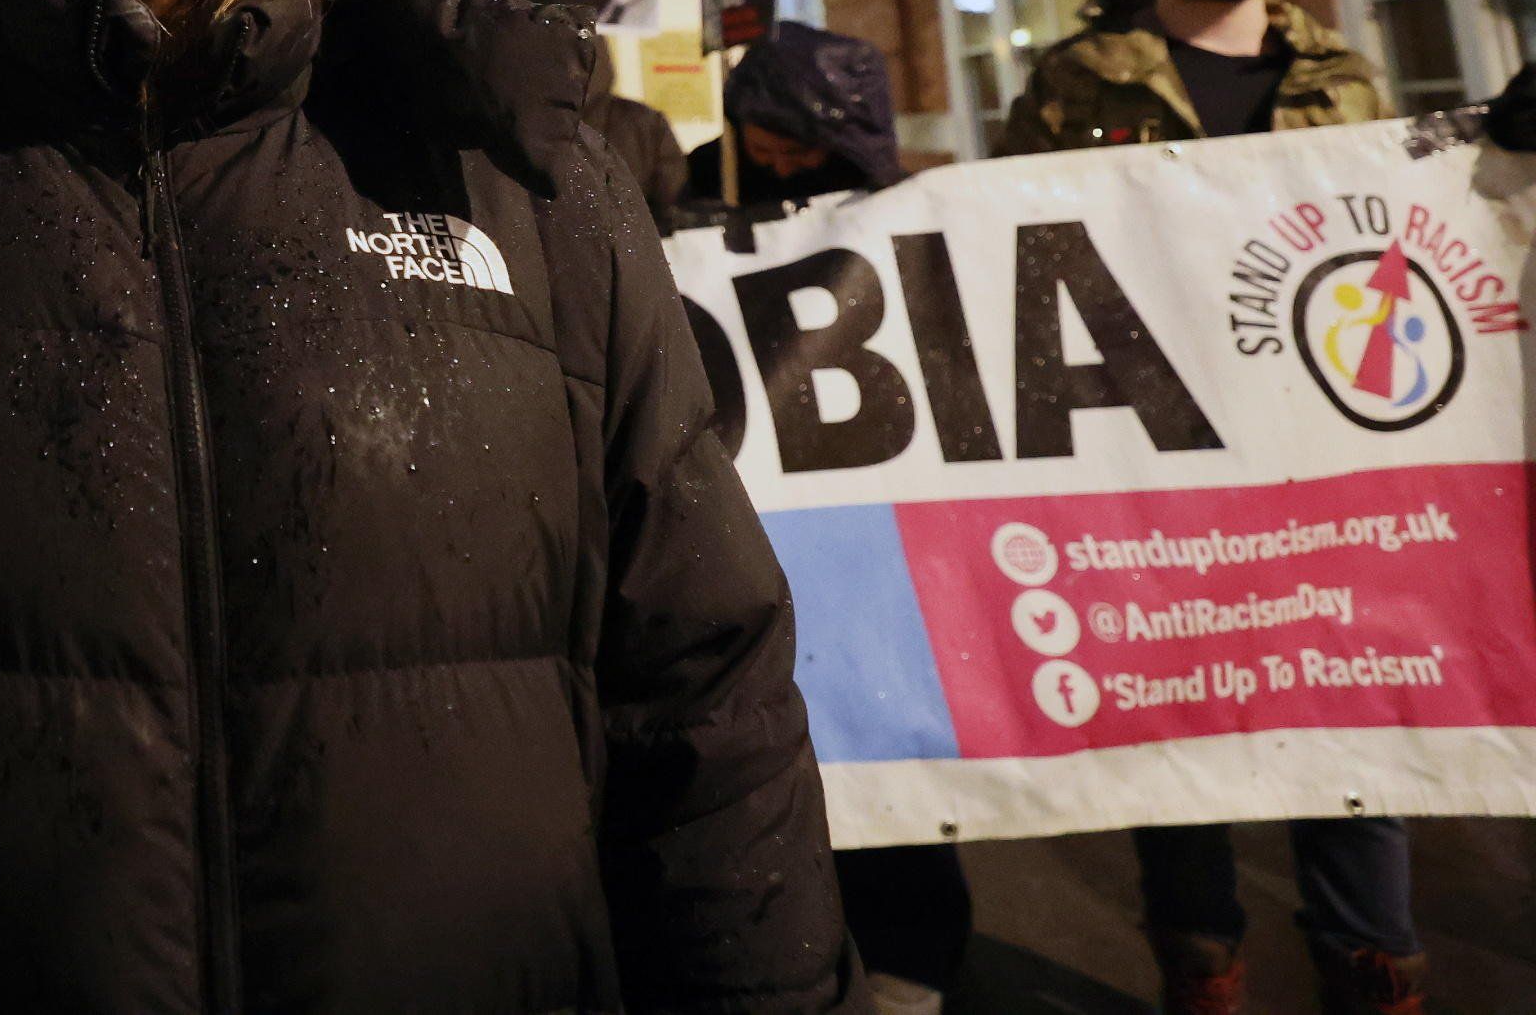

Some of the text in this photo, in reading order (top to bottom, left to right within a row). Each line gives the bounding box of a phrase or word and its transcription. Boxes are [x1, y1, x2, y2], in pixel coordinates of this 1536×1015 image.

[346, 227, 457, 260] NORTH
[383, 212, 446, 236] THE
[385, 255, 466, 285] FACE
[1229, 193, 1529, 356] STAND UP TO RACISM
[1064, 502, 1457, 575] standuptoracism.org.uk
[1088, 583, 1354, 643] @AntiRacismDay
[1103, 644, 1444, 711] 'Stand Up To Racism'
